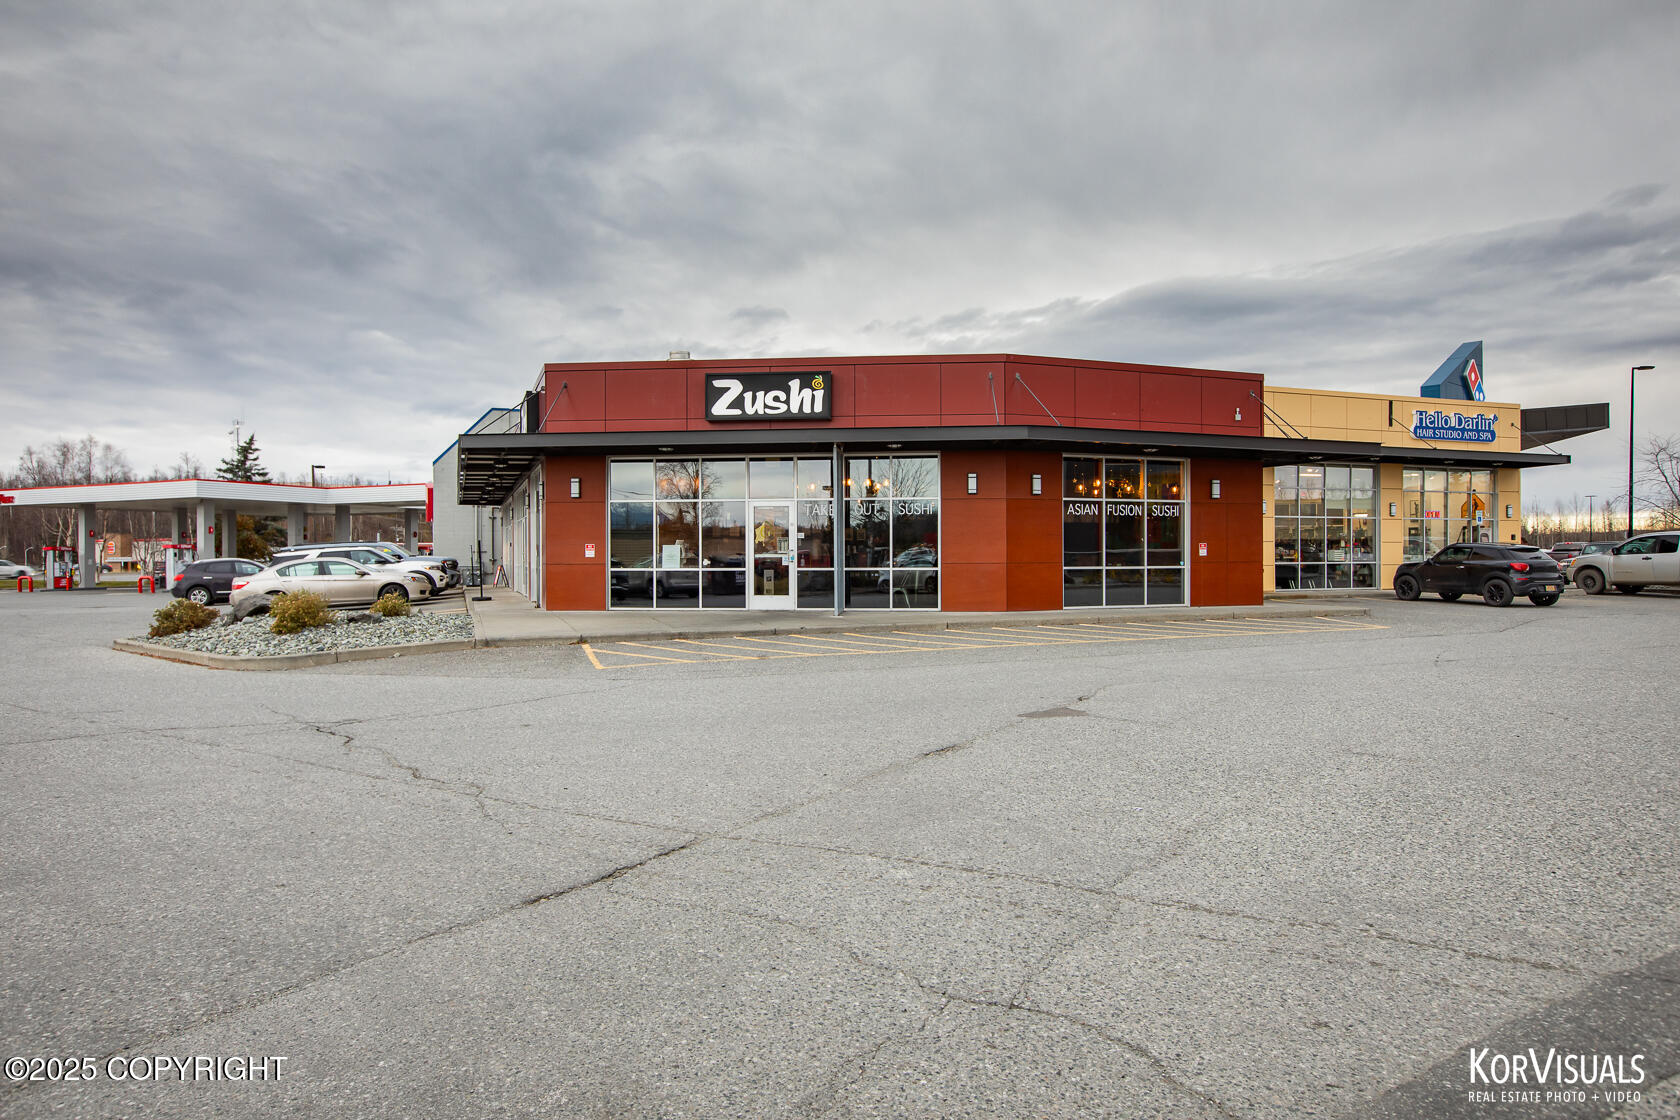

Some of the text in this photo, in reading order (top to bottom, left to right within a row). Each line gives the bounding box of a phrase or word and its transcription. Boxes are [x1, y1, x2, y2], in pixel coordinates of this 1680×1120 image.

[711, 377, 825, 415] Zushi
[1416, 411, 1451, 428] Hello
[1416, 428, 1492, 440] HAIR STUDIO AND SPA
[854, 503, 880, 516] OUT
[898, 502, 933, 515] SUSHI
[1066, 503, 1180, 517] ASIAN FUSION SUSHI
